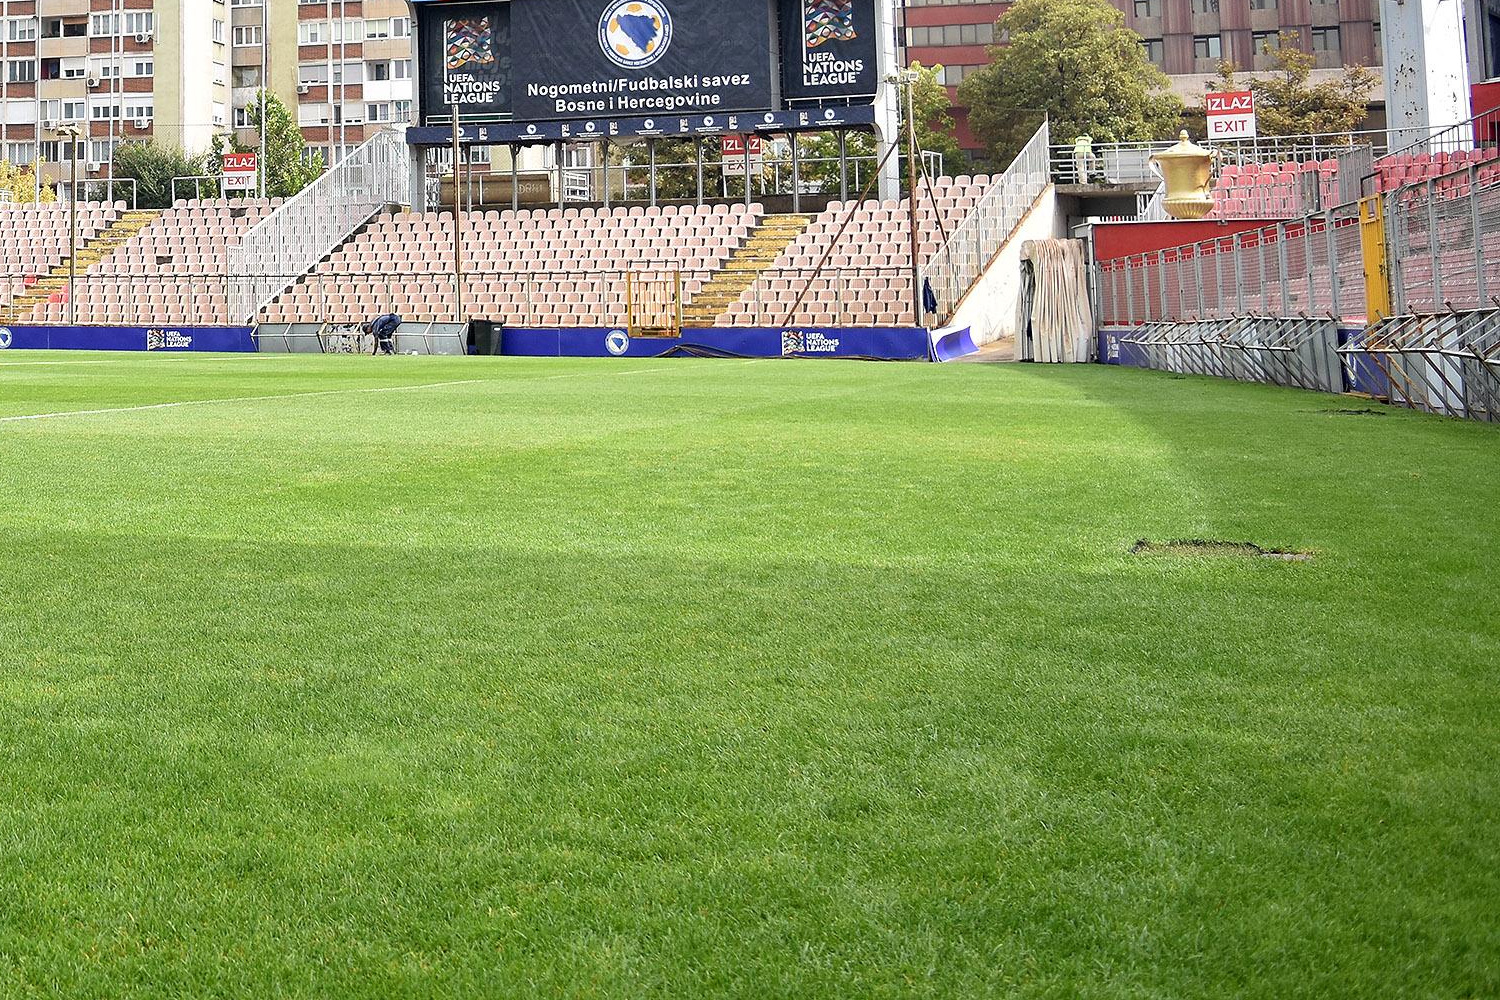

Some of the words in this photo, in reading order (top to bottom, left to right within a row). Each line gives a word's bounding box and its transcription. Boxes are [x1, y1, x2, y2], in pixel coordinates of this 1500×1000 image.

[808, 52, 835, 62] UEFA
[803, 60, 864, 74] NATIONS
[449, 74, 475, 82] UEFA
[803, 72, 857, 86] LEAGUE
[443, 81, 501, 93] NATIONS
[527, 75, 698, 98] Nogometni/Fudbalski
[701, 74, 750, 88] savez
[443, 92, 494, 104] LEAGUE
[555, 97, 605, 112] Bosne
[609, 96, 613, 110] i
[617, 92, 721, 110] Hercegovine
[1207, 96, 1252, 110] IZLAZ
[1214, 120, 1247, 132] EXIT
[723, 139, 759, 150] IZLZ
[224, 157, 255, 167] IZLAZ
[728, 160, 756, 170] EXT
[228, 176, 251, 185] EXIT
